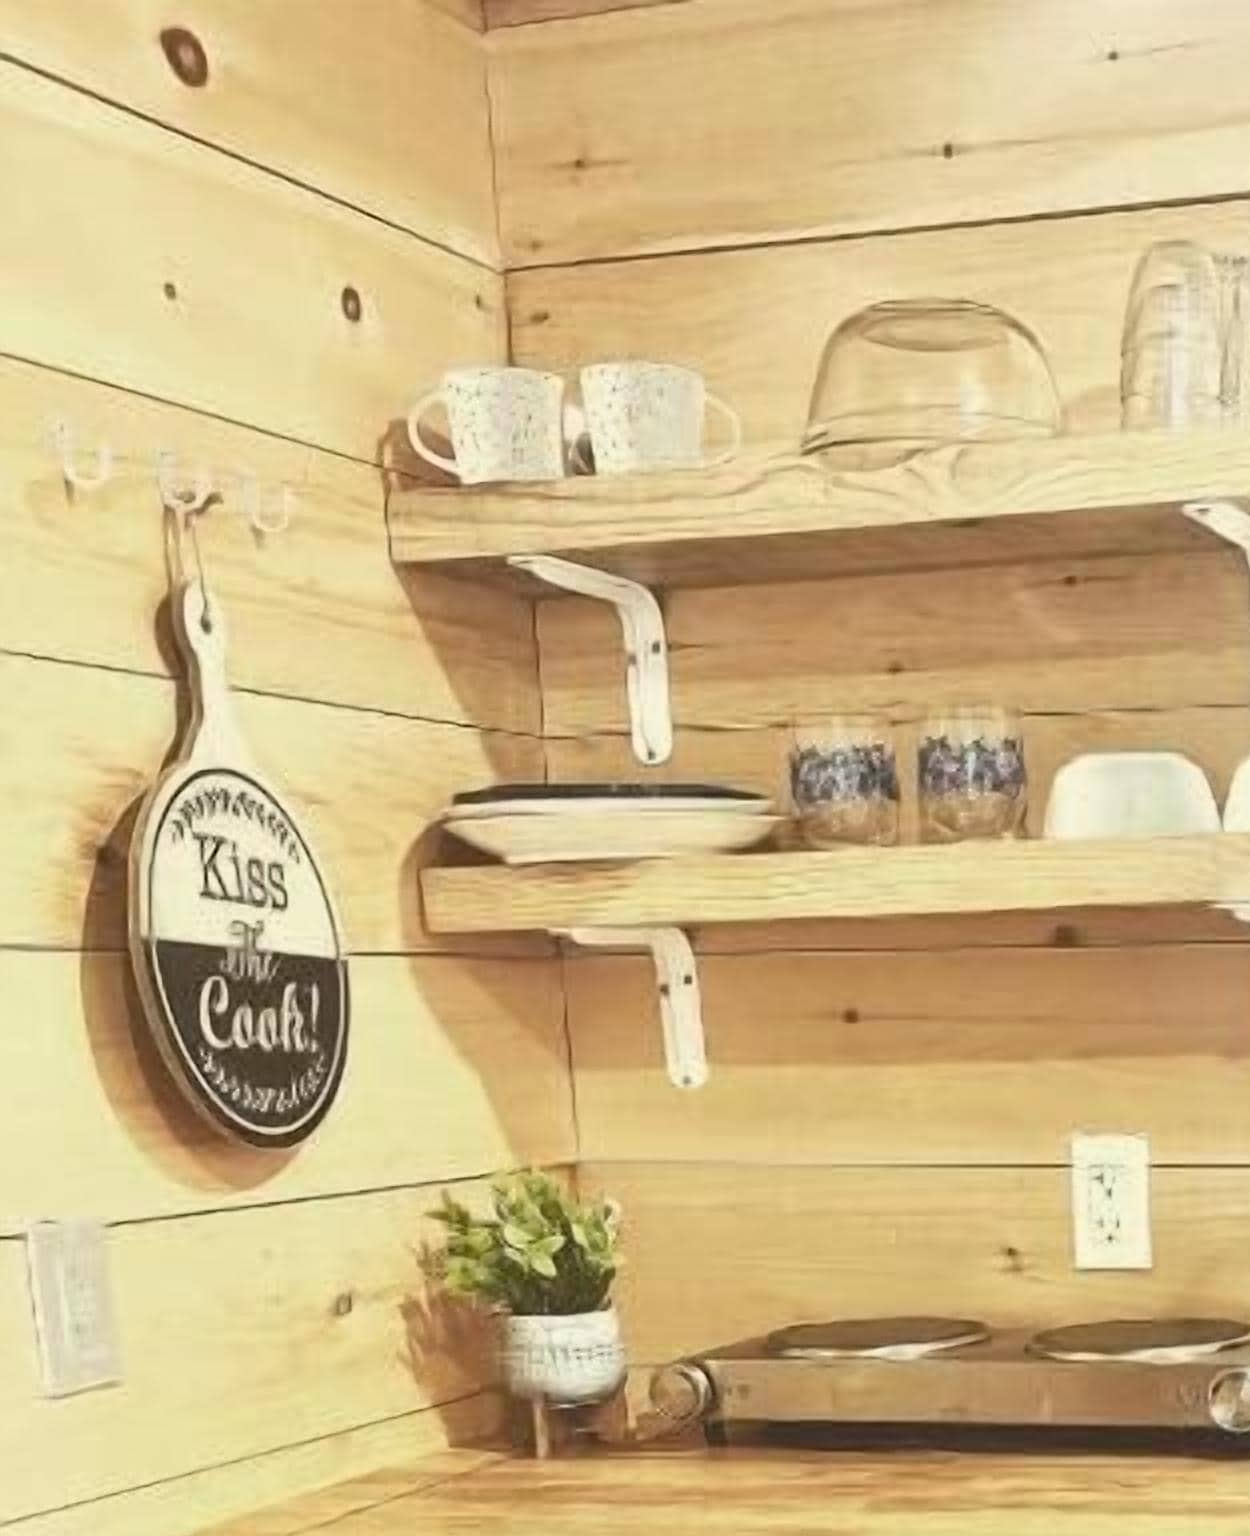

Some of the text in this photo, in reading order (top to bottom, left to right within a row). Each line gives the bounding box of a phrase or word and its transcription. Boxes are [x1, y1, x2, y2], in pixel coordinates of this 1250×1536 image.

[193, 832, 289, 910] Kiss
[222, 919, 280, 983] The
[199, 974, 320, 1053] Cook!
